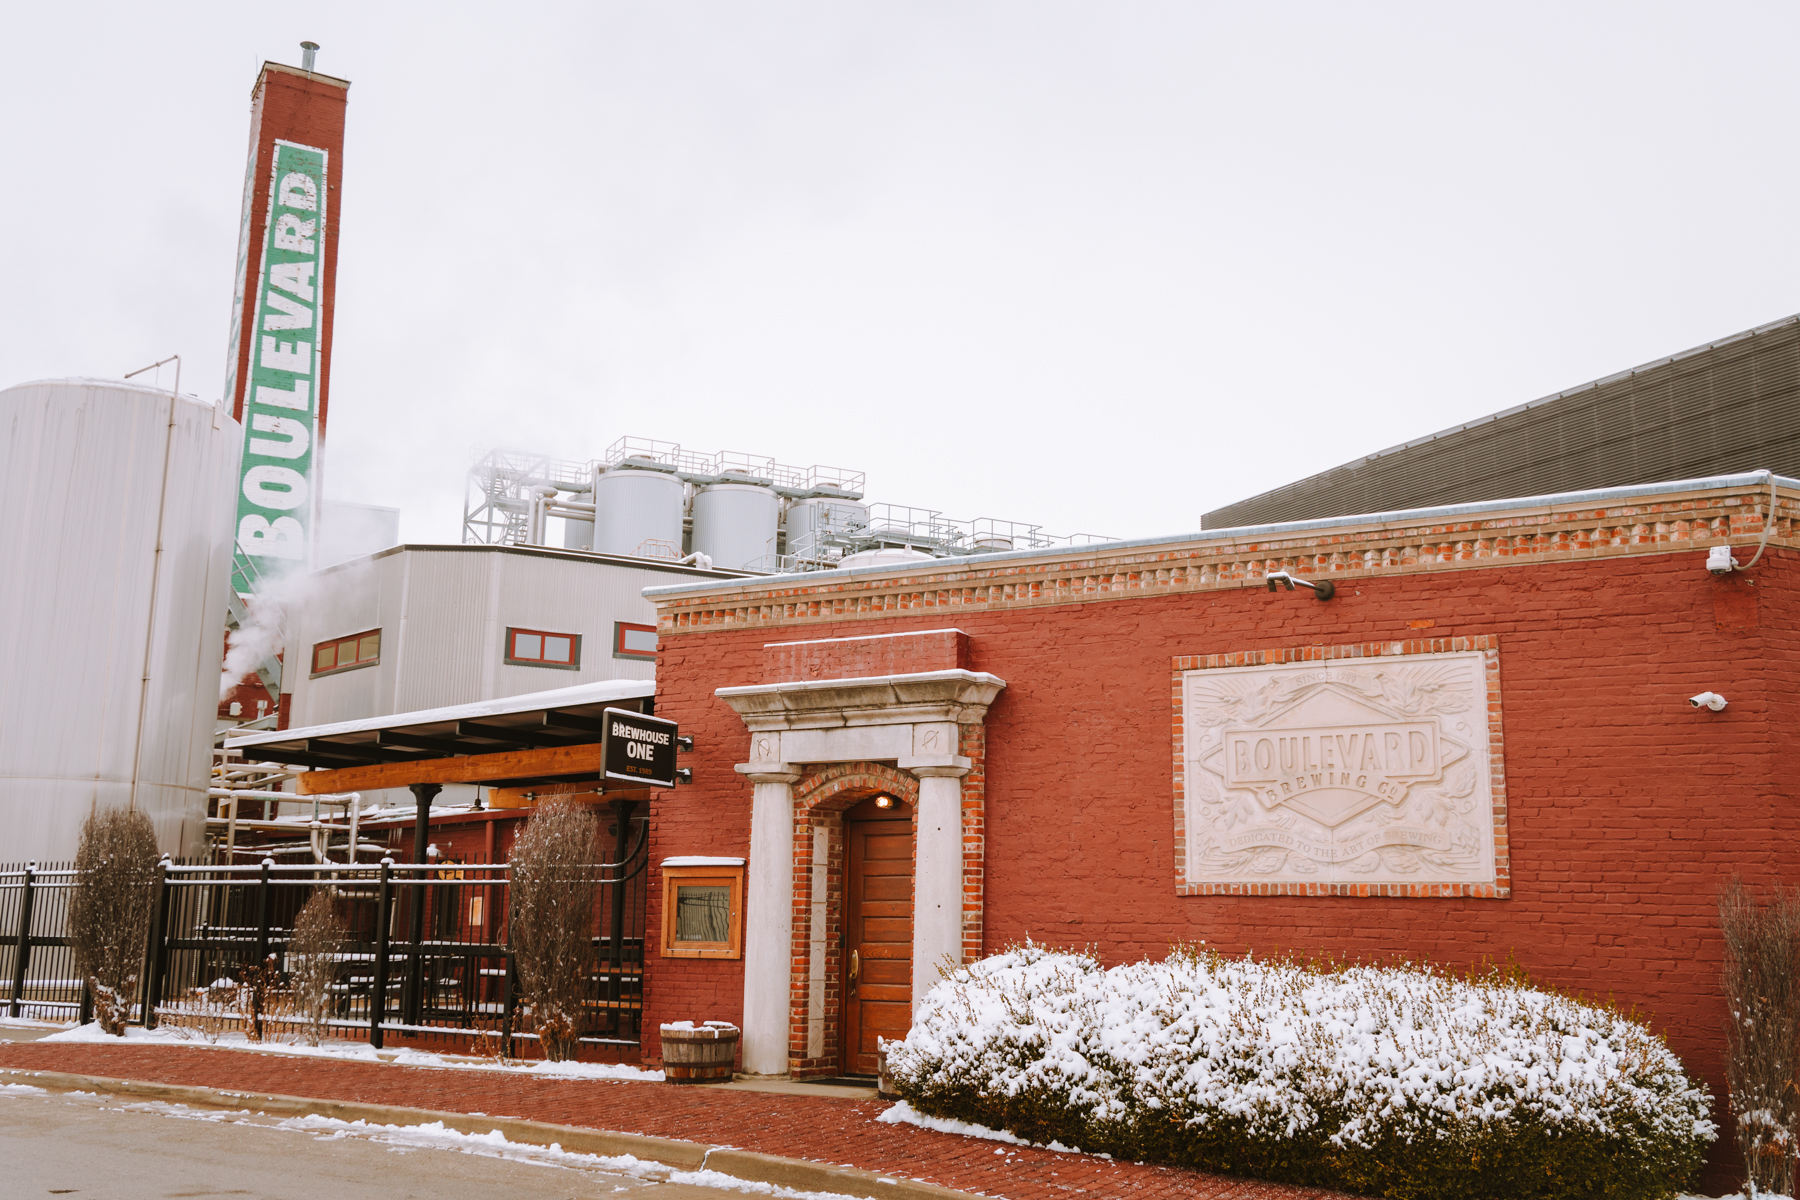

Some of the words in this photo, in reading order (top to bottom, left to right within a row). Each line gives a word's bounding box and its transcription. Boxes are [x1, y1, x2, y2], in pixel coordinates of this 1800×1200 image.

[236, 170, 319, 561] BOULEVARD
[1296, 671, 1332, 686] SINCE
[1335, 671, 1356, 683] 1989
[612, 721, 670, 746] BREWHOUSE
[626, 740, 655, 761] ONE
[1234, 730, 1430, 776] BOULEVARD
[626, 765, 638, 773] EST.
[638, 767, 653, 776] 1989
[1265, 772, 1367, 803] BREWING
[1229, 832, 1294, 848] DEDICATED
[1297, 840, 1311, 853] TO
[1314, 846, 1338, 858] THE
[1342, 842, 1364, 857] ART
[1366, 833, 1382, 846] OF
[1384, 830, 1442, 844] BREWING
